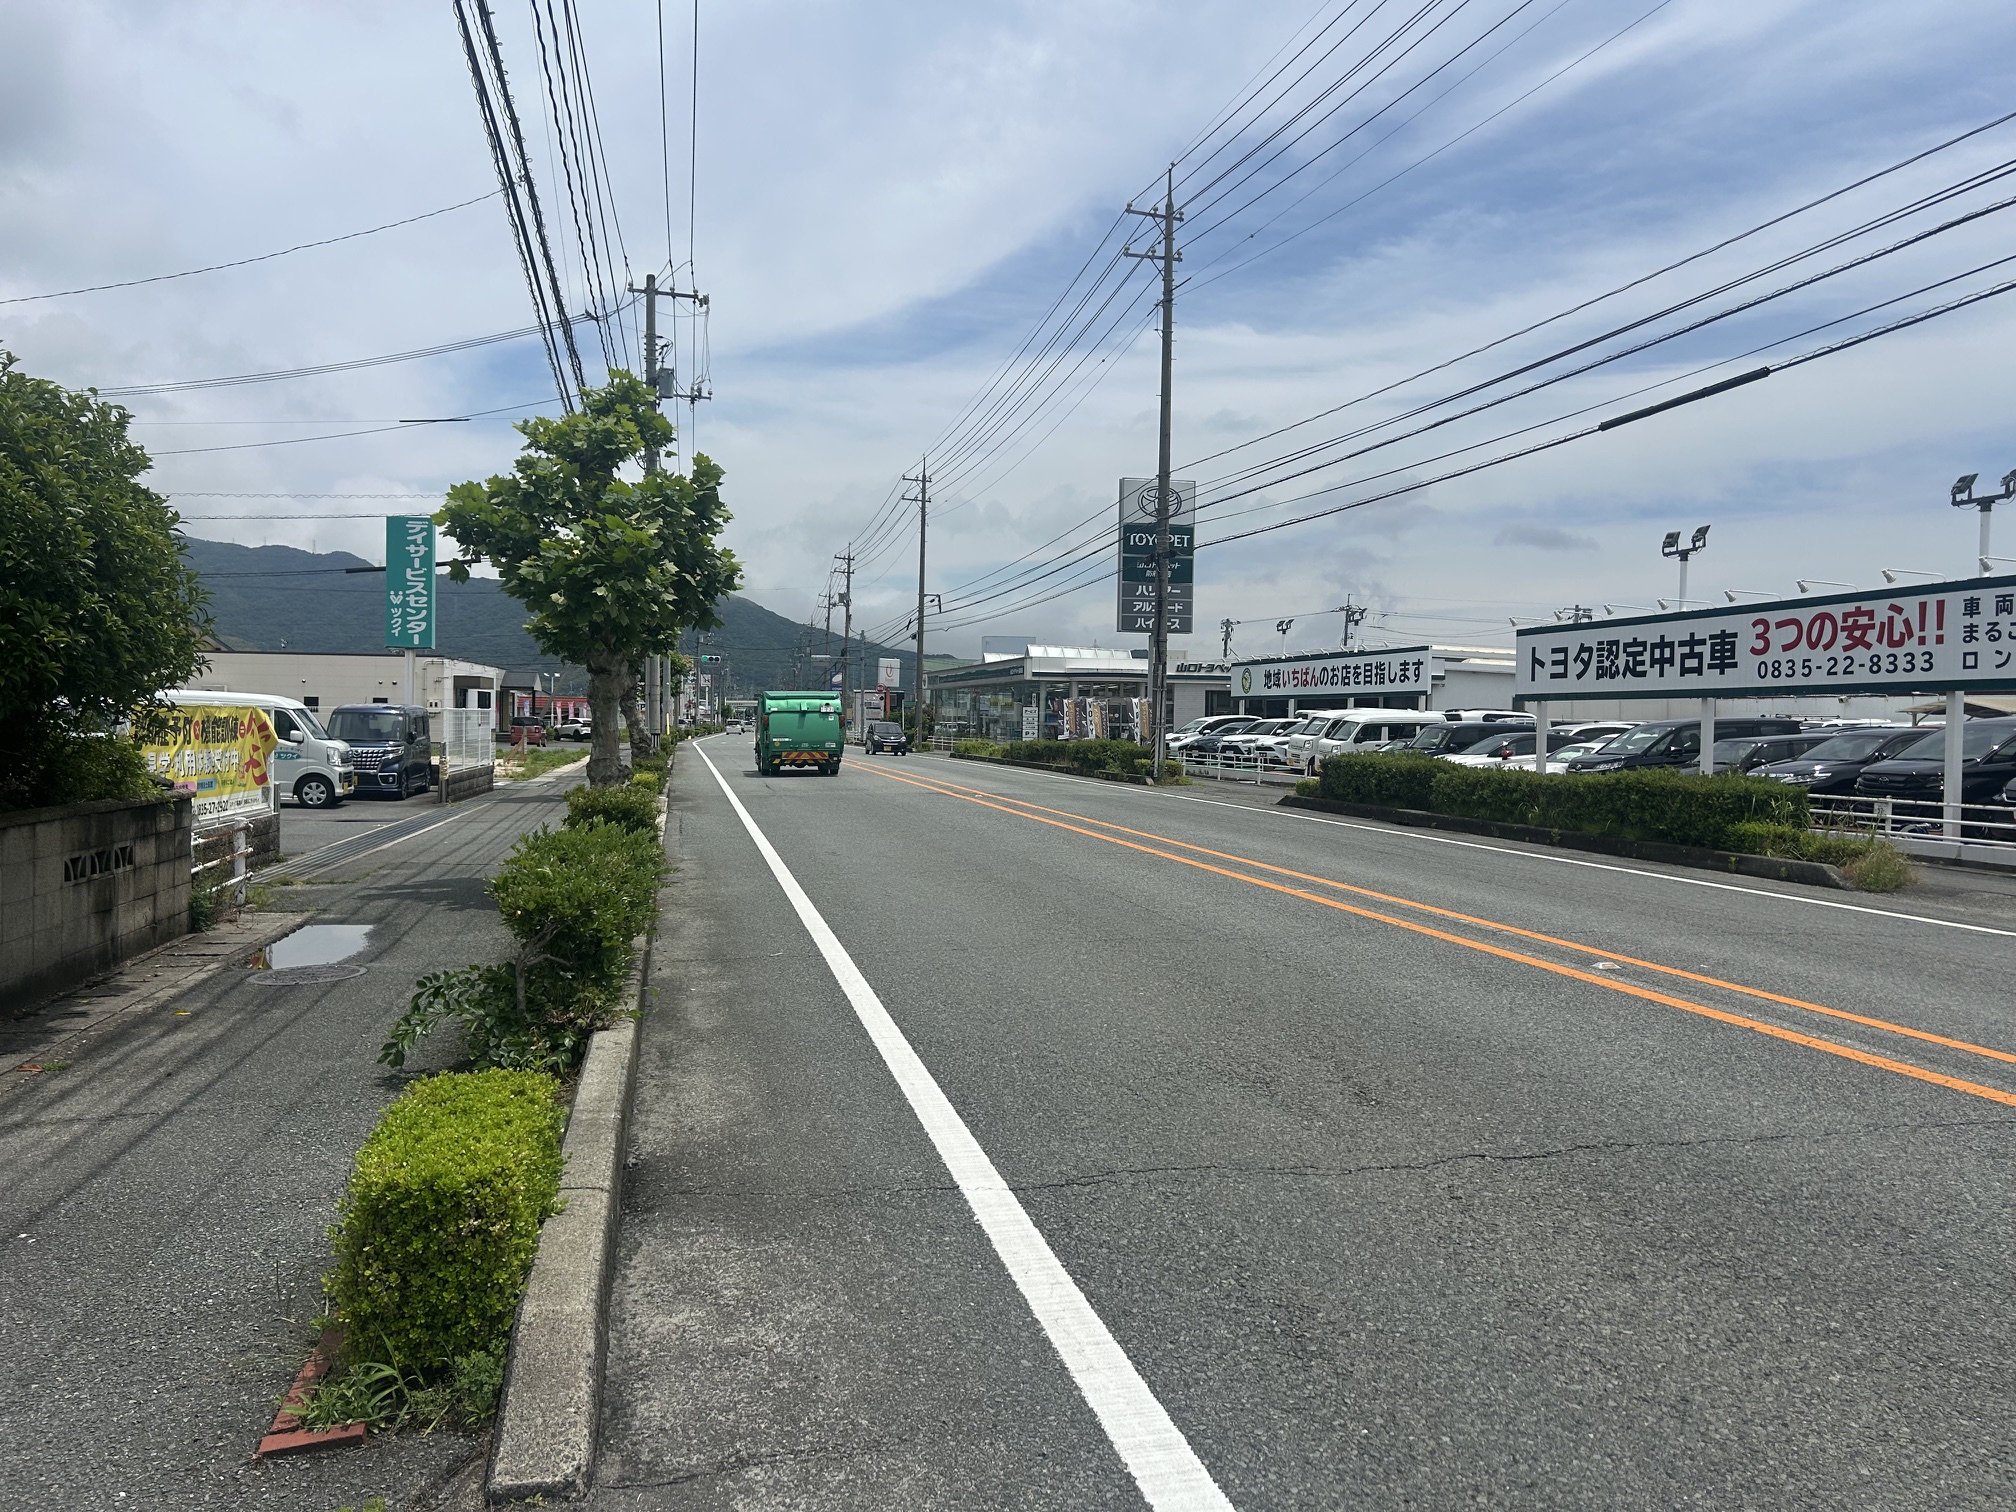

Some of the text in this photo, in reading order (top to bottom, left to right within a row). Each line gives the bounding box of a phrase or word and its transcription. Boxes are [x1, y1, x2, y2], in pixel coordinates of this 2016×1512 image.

[405, 520, 429, 645] デイサービスセンター
[390, 607, 402, 637] ツクイ
[1133, 601, 1184, 613] アルード
[1134, 617, 1181, 629] ハイース
[1749, 599, 1946, 656] 3つの安心!!
[1530, 629, 1738, 682] トヨタ認定中古車
[1757, 651, 1934, 680] 0835-22-8333
[1263, 658, 1424, 690] 地域いちばんのお店を目指します
